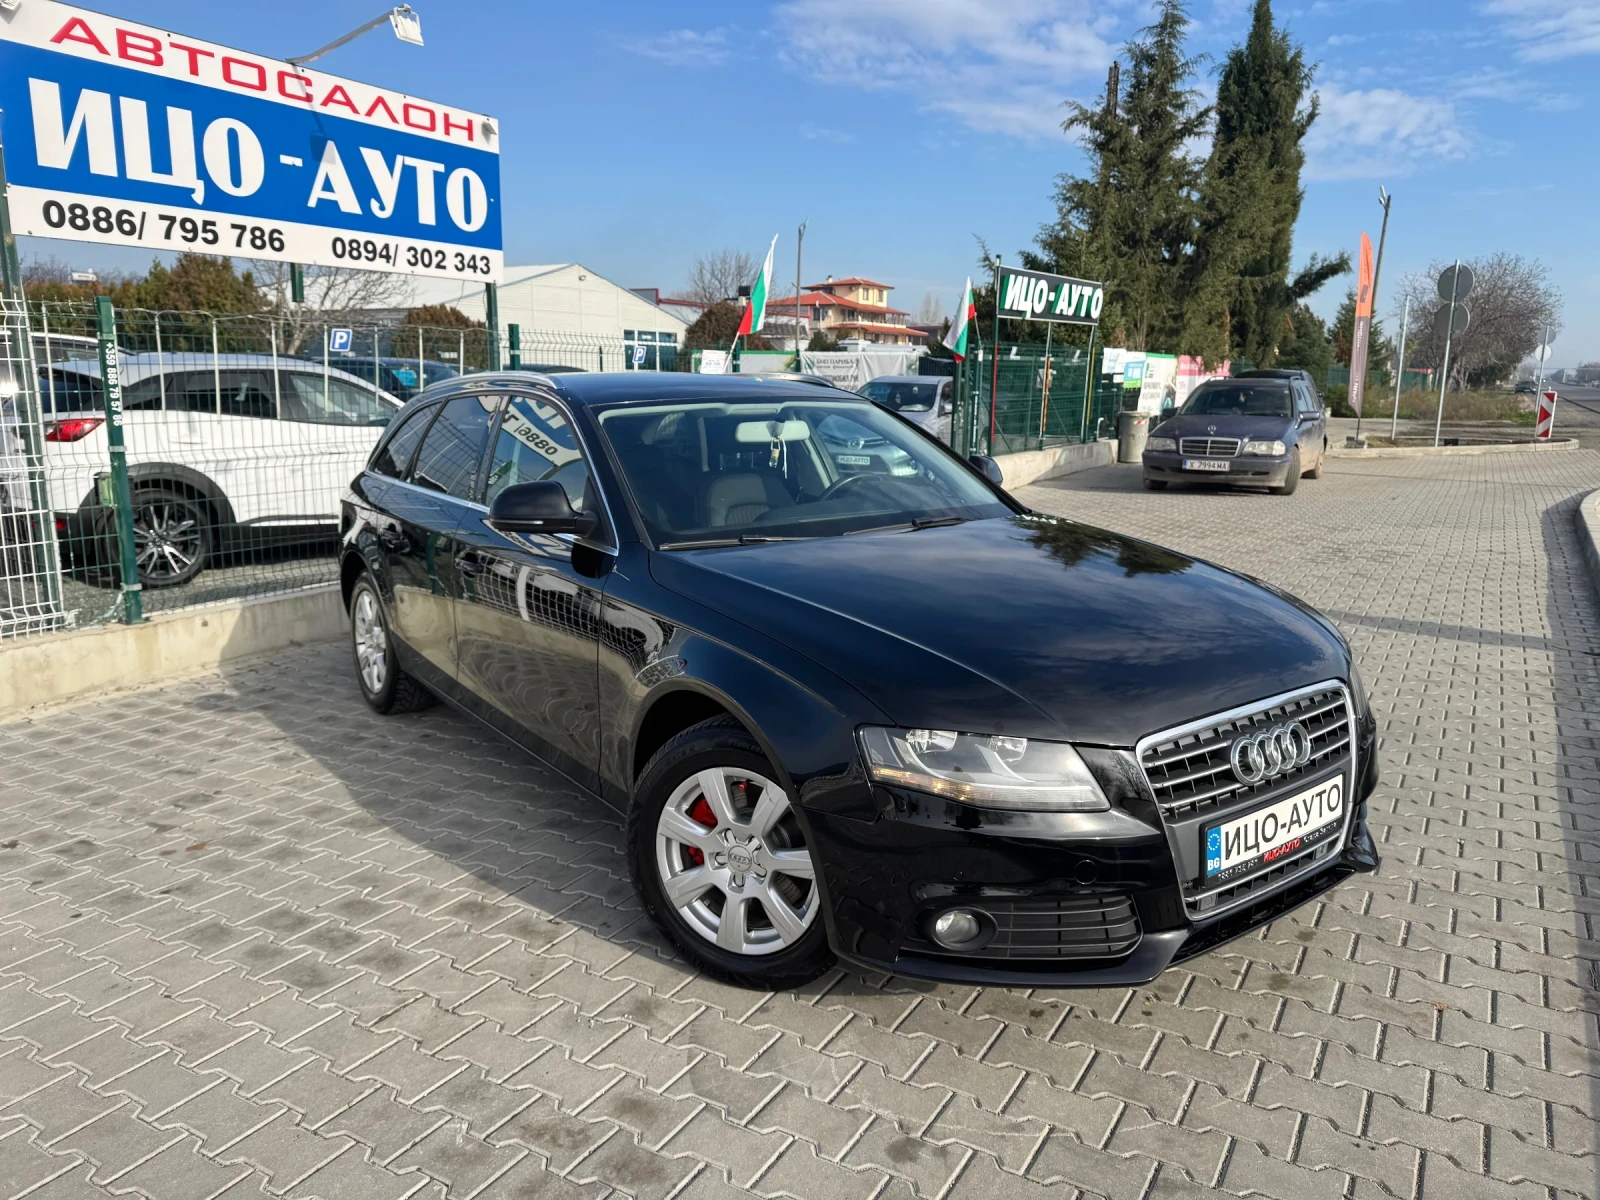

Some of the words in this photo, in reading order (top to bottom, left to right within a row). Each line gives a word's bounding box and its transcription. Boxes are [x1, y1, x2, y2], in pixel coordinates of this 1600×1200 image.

[50, 16, 475, 142] АВТОСАЛОН
[42, 199, 146, 240] 0886/
[158, 214, 220, 245] 795
[230, 223, 286, 252] 786
[331, 237, 398, 265] 0894/
[406, 245, 447, 270] 302
[453, 252, 492, 275] 343
[1004, 274, 1103, 319] ИЦО-АУТО
[334, 331, 348, 349] P
[107, 367, 117, 385] 886
[1198, 461, 1216, 469] 7994
[1224, 783, 1341, 861] ИЦО-АУТО
[1207, 857, 1220, 871] BG
